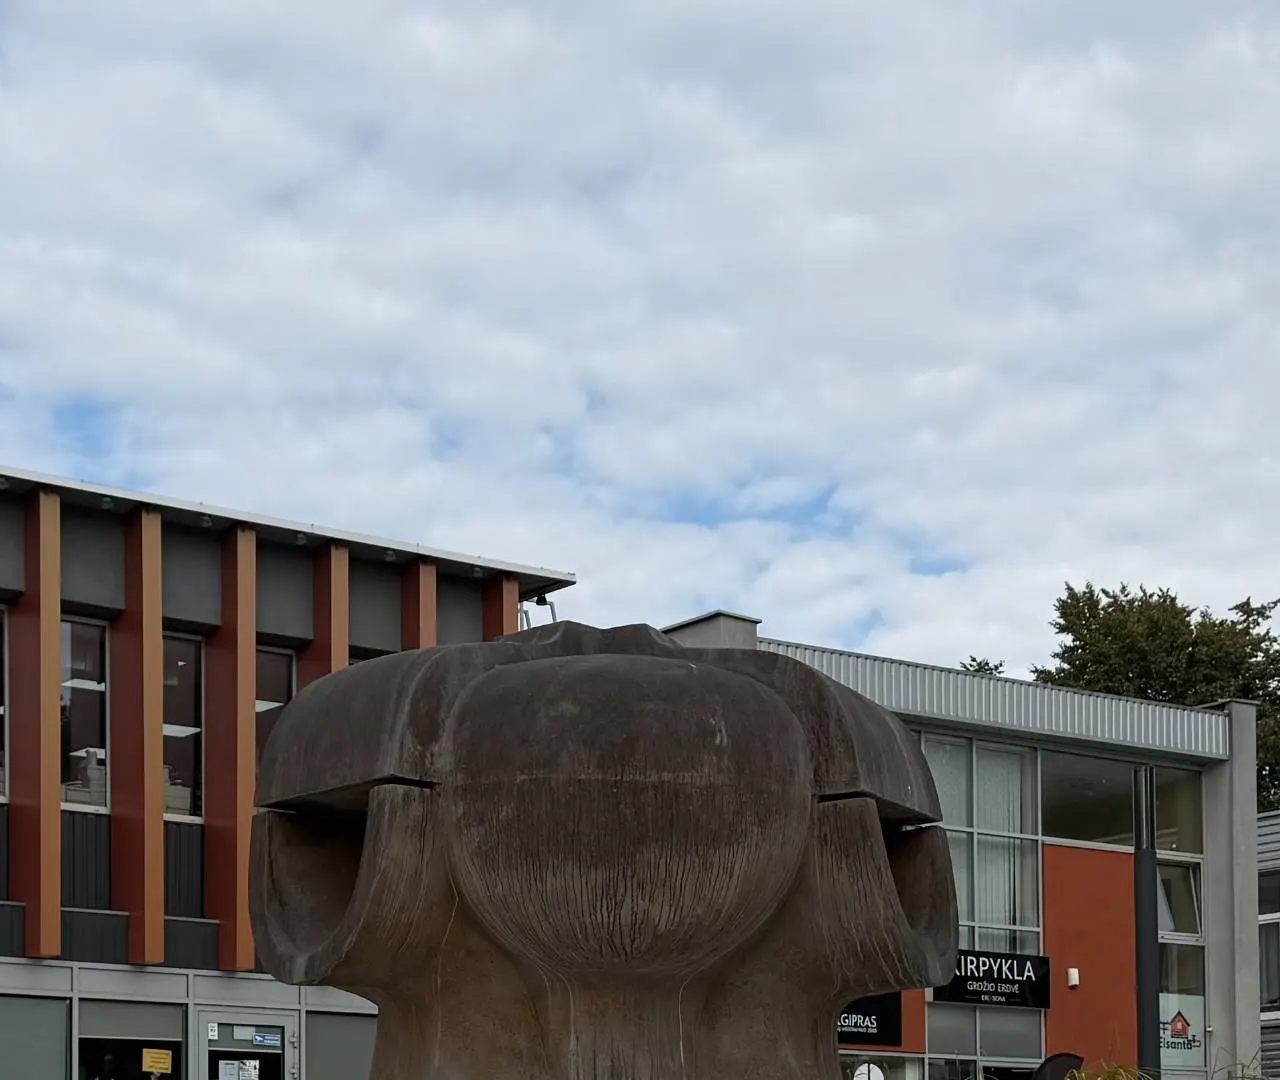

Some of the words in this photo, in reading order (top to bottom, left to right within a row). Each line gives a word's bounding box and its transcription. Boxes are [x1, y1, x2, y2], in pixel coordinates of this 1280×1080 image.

[966, 980, 996, 992] GROŽIO
[997, 983, 1020, 994] ERDVĖ
[837, 1013, 877, 1028] LGIPRAS
